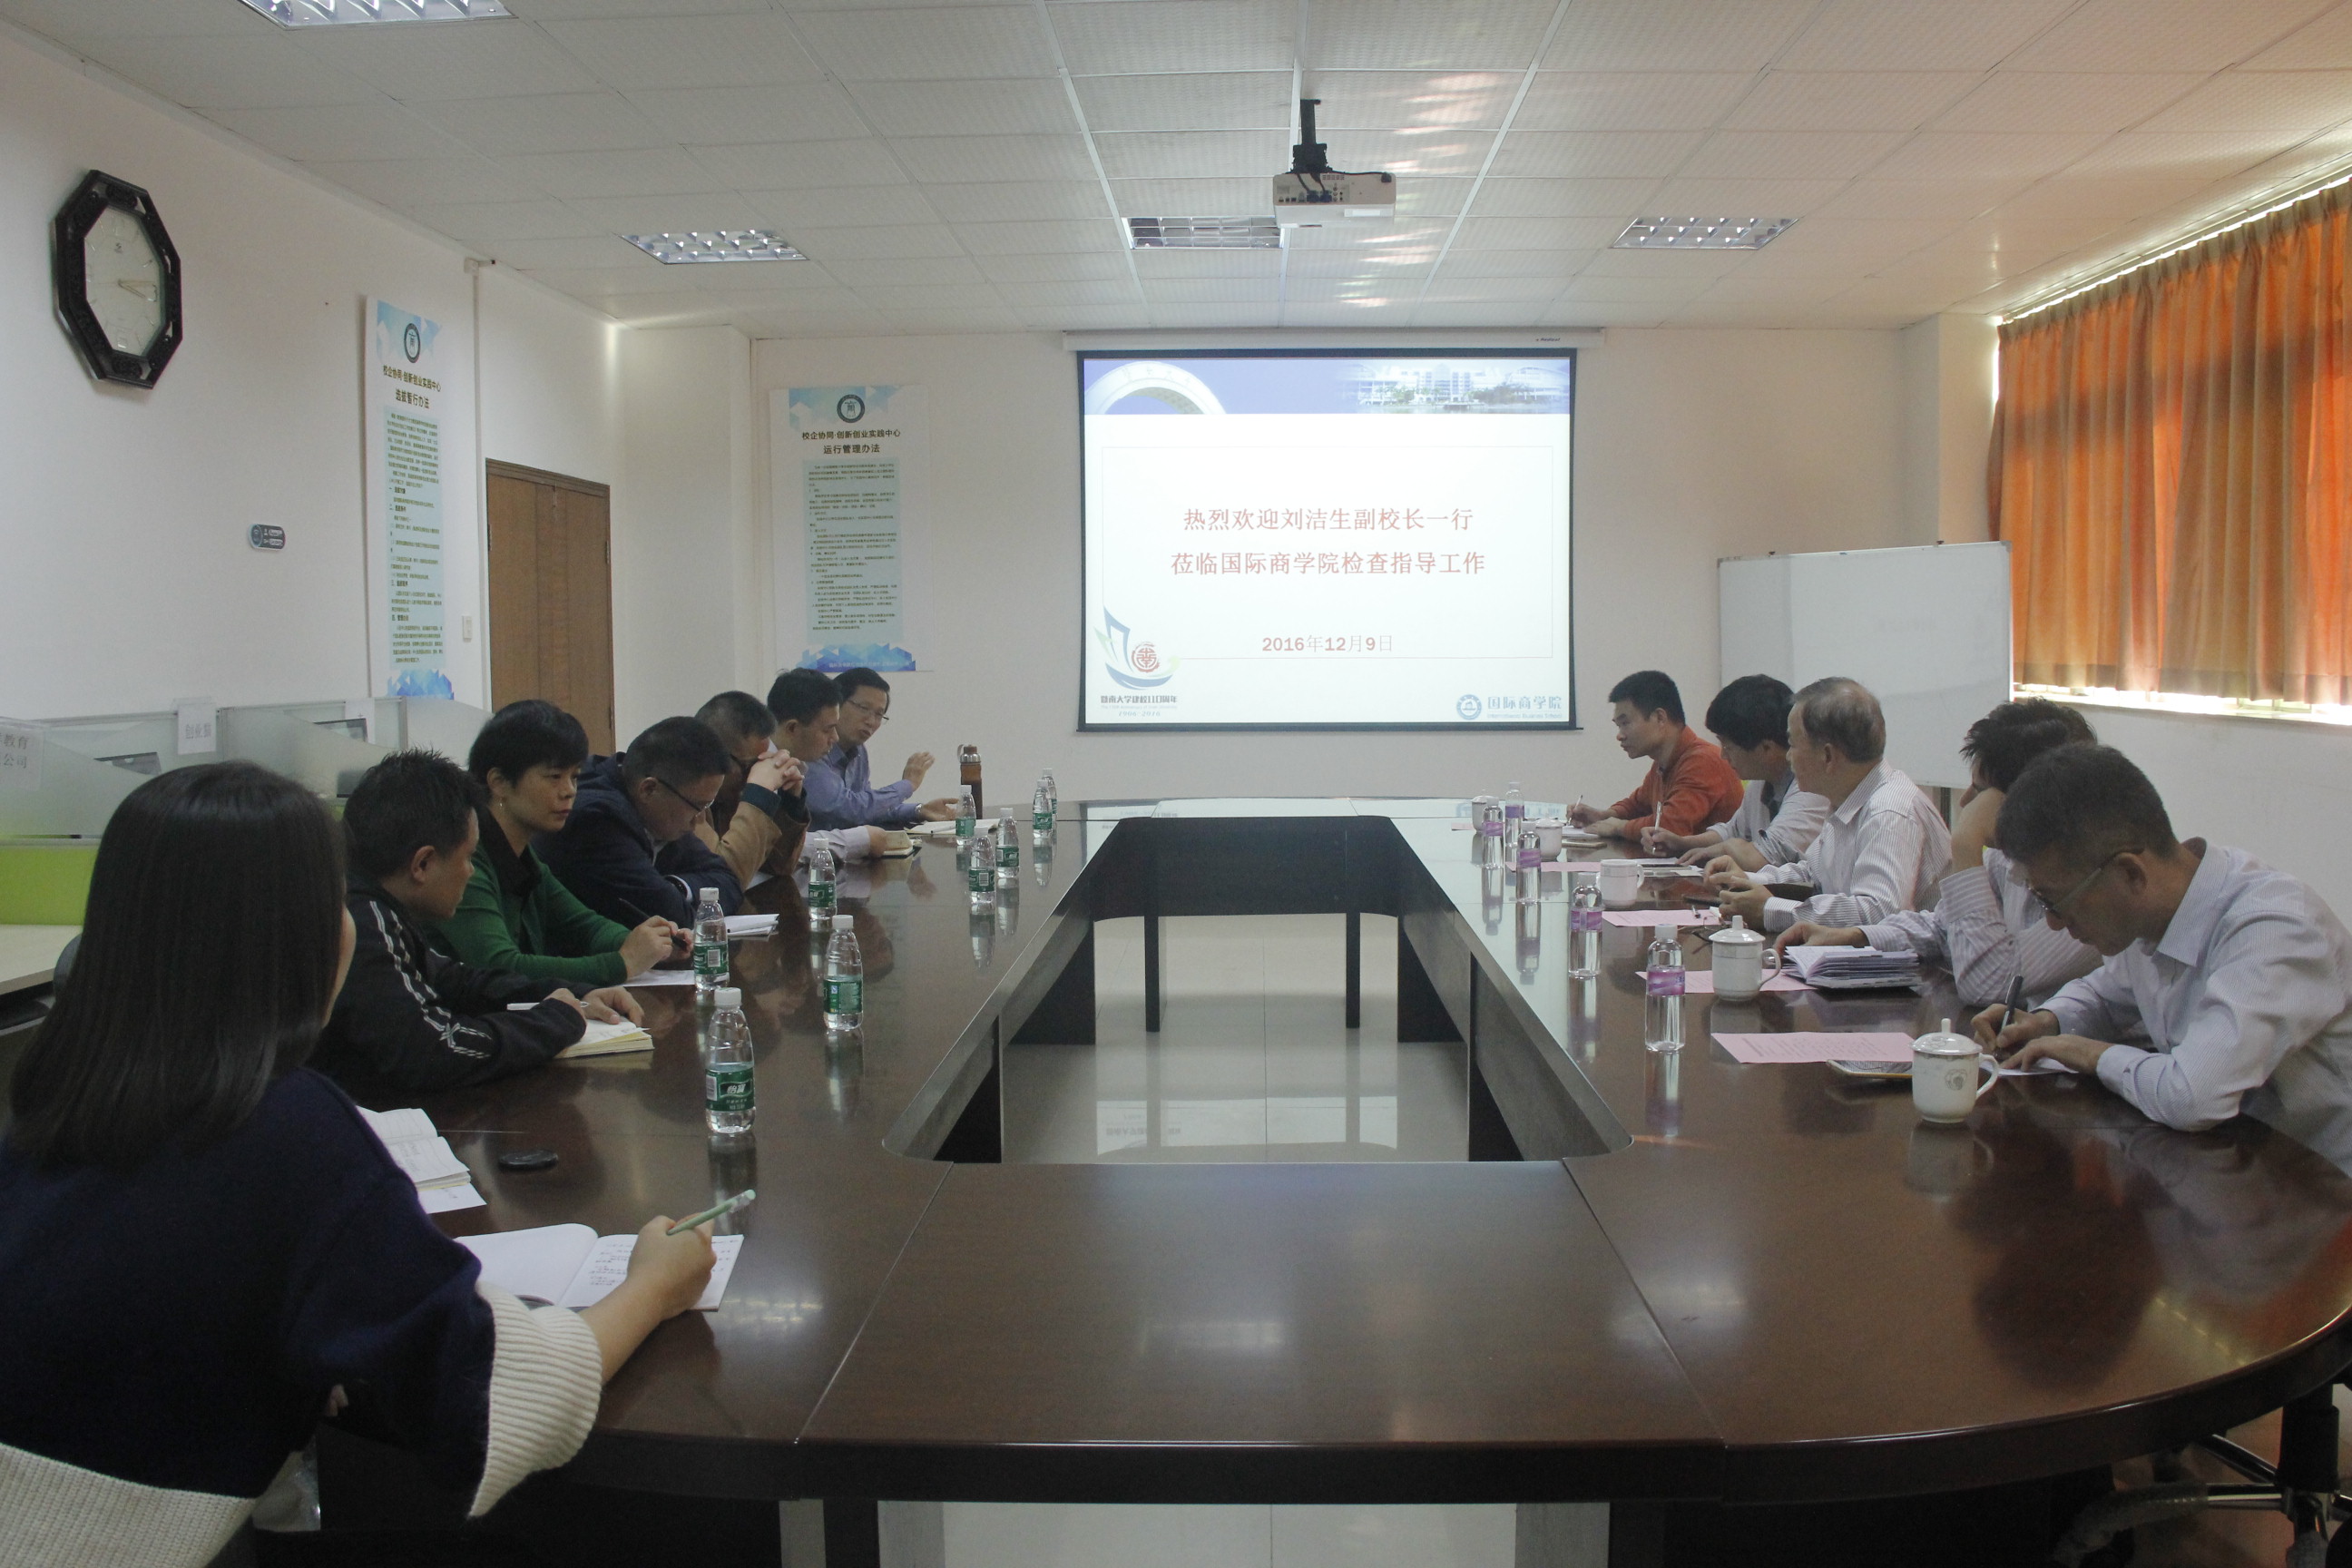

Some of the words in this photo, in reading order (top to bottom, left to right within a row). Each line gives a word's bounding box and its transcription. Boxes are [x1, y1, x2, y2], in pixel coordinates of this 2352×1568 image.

[823, 444, 881, 455] 运行管理办法
[1182, 507, 1475, 532] 热烈欢迎刘洁生副校长一行
[1170, 551, 1486, 576] 莅临国际商学院检查指导工作
[1261, 634, 1394, 653] 2016年12月9日
[1100, 695, 1178, 704] 暨南大学建校110周年
[1487, 696, 1562, 710] 国际商学院
[0, 732, 30, 750] 教育
[0, 753, 28, 769] 公司
